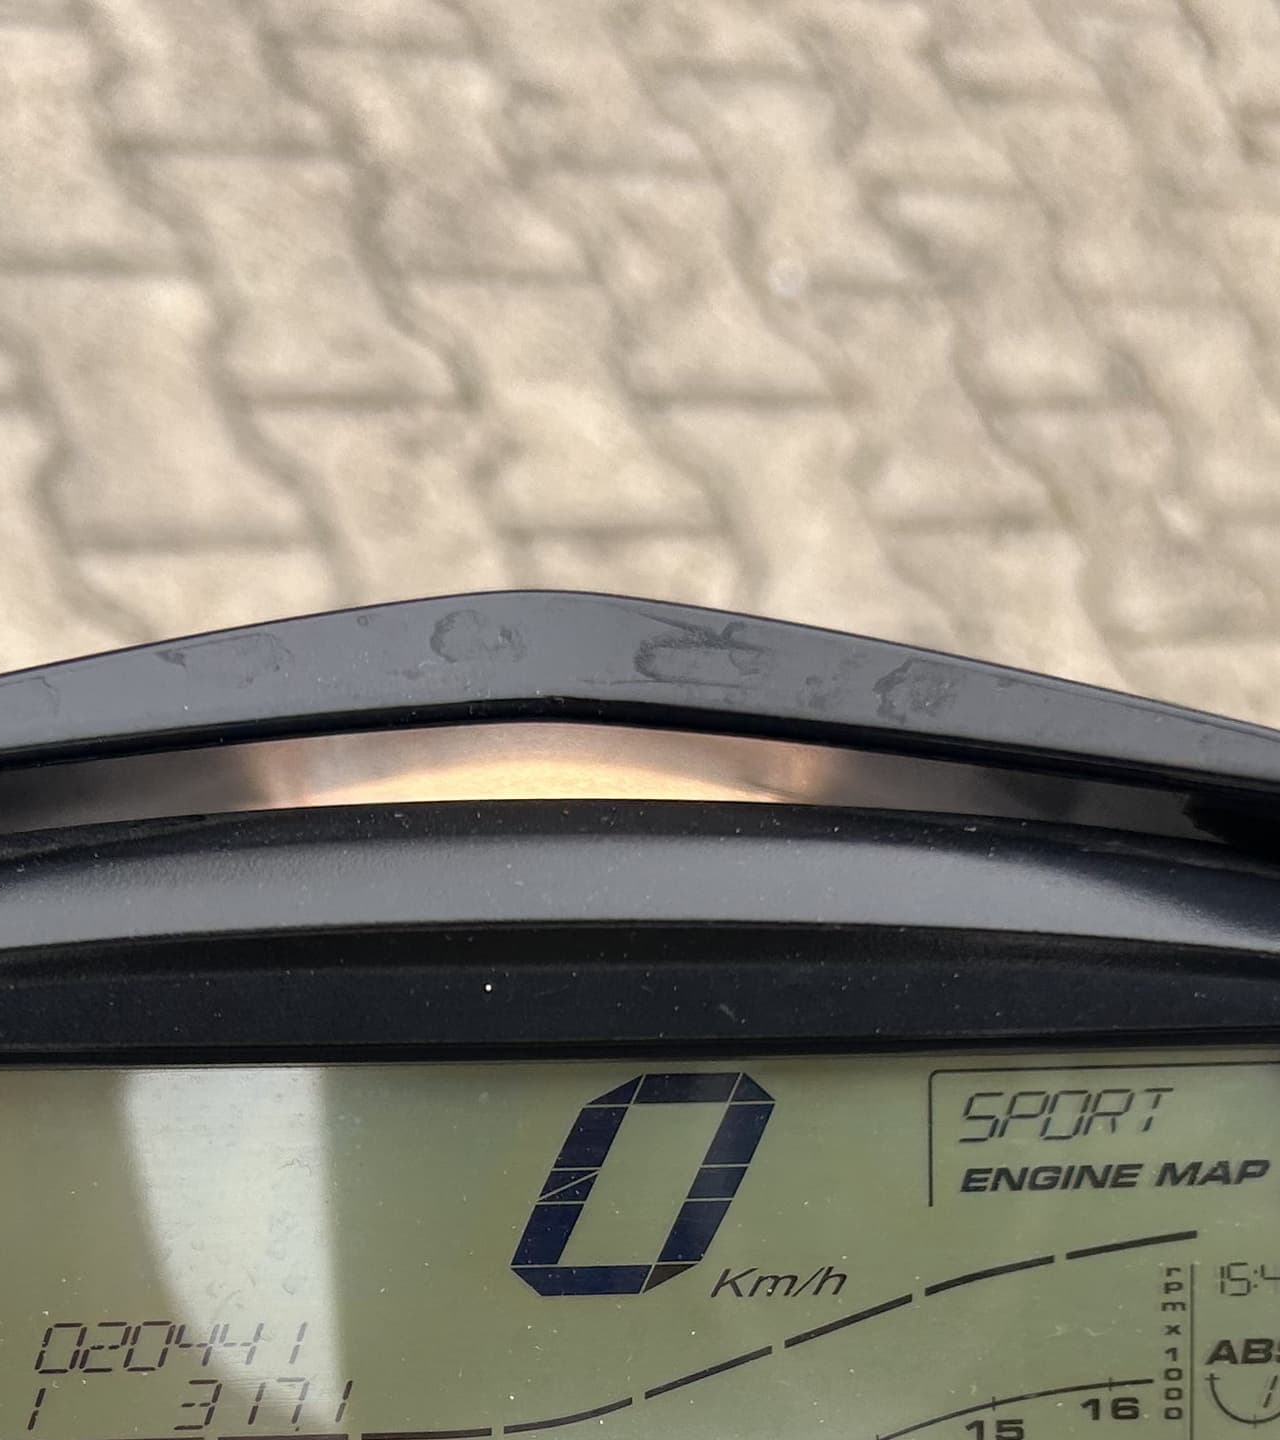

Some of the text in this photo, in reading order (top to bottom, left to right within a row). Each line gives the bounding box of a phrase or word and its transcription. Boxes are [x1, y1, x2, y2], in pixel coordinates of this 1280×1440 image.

[958, 1087, 1174, 1144] SPORT
[510, 1071, 776, 1297] 0
[959, 1159, 1271, 1194] ENGINE MAP
[710, 1266, 848, 1298] Km/h
[35, 1320, 308, 1375] 020441
[27, 1387, 46, 1430] 1
[1080, 1397, 1140, 1421] 16
[1263, 1374, 1278, 1409] 1
